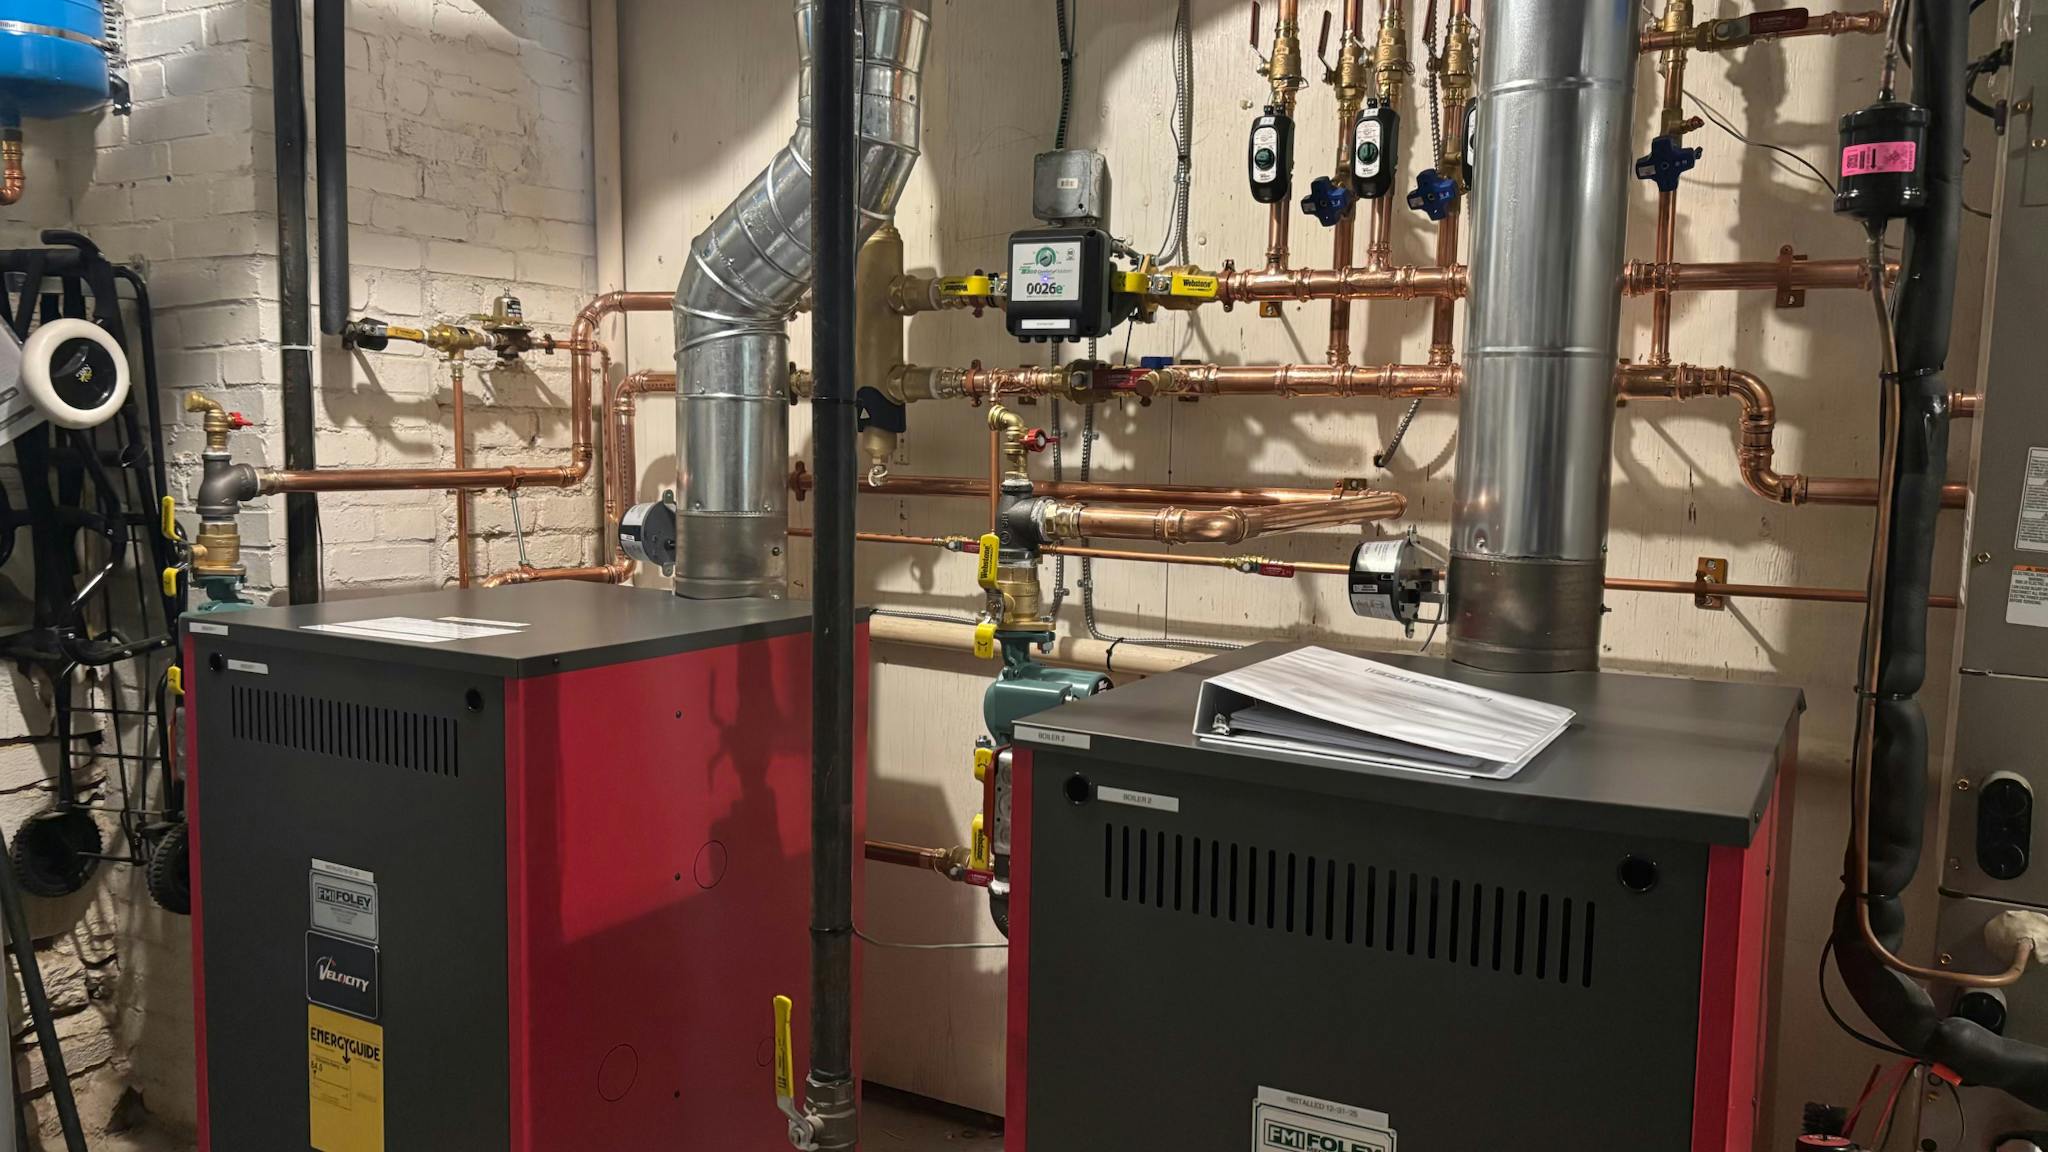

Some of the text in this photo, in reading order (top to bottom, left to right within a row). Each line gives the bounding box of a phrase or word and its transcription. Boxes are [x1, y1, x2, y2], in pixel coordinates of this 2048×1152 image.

[1026, 283, 1063, 295] 0026e
[1183, 279, 1211, 288] Webstone
[980, 544, 991, 579] Webstone
[1038, 731, 1060, 741] BOILER
[1123, 793, 1147, 804] BOILER
[336, 892, 371, 907] FOLEY
[319, 956, 369, 992] VELOCITY
[310, 1027, 381, 1063] ENERGYGUIDE
[1286, 1095, 1325, 1111] INSTALLED
[1269, 1125, 1304, 1149] FMI
